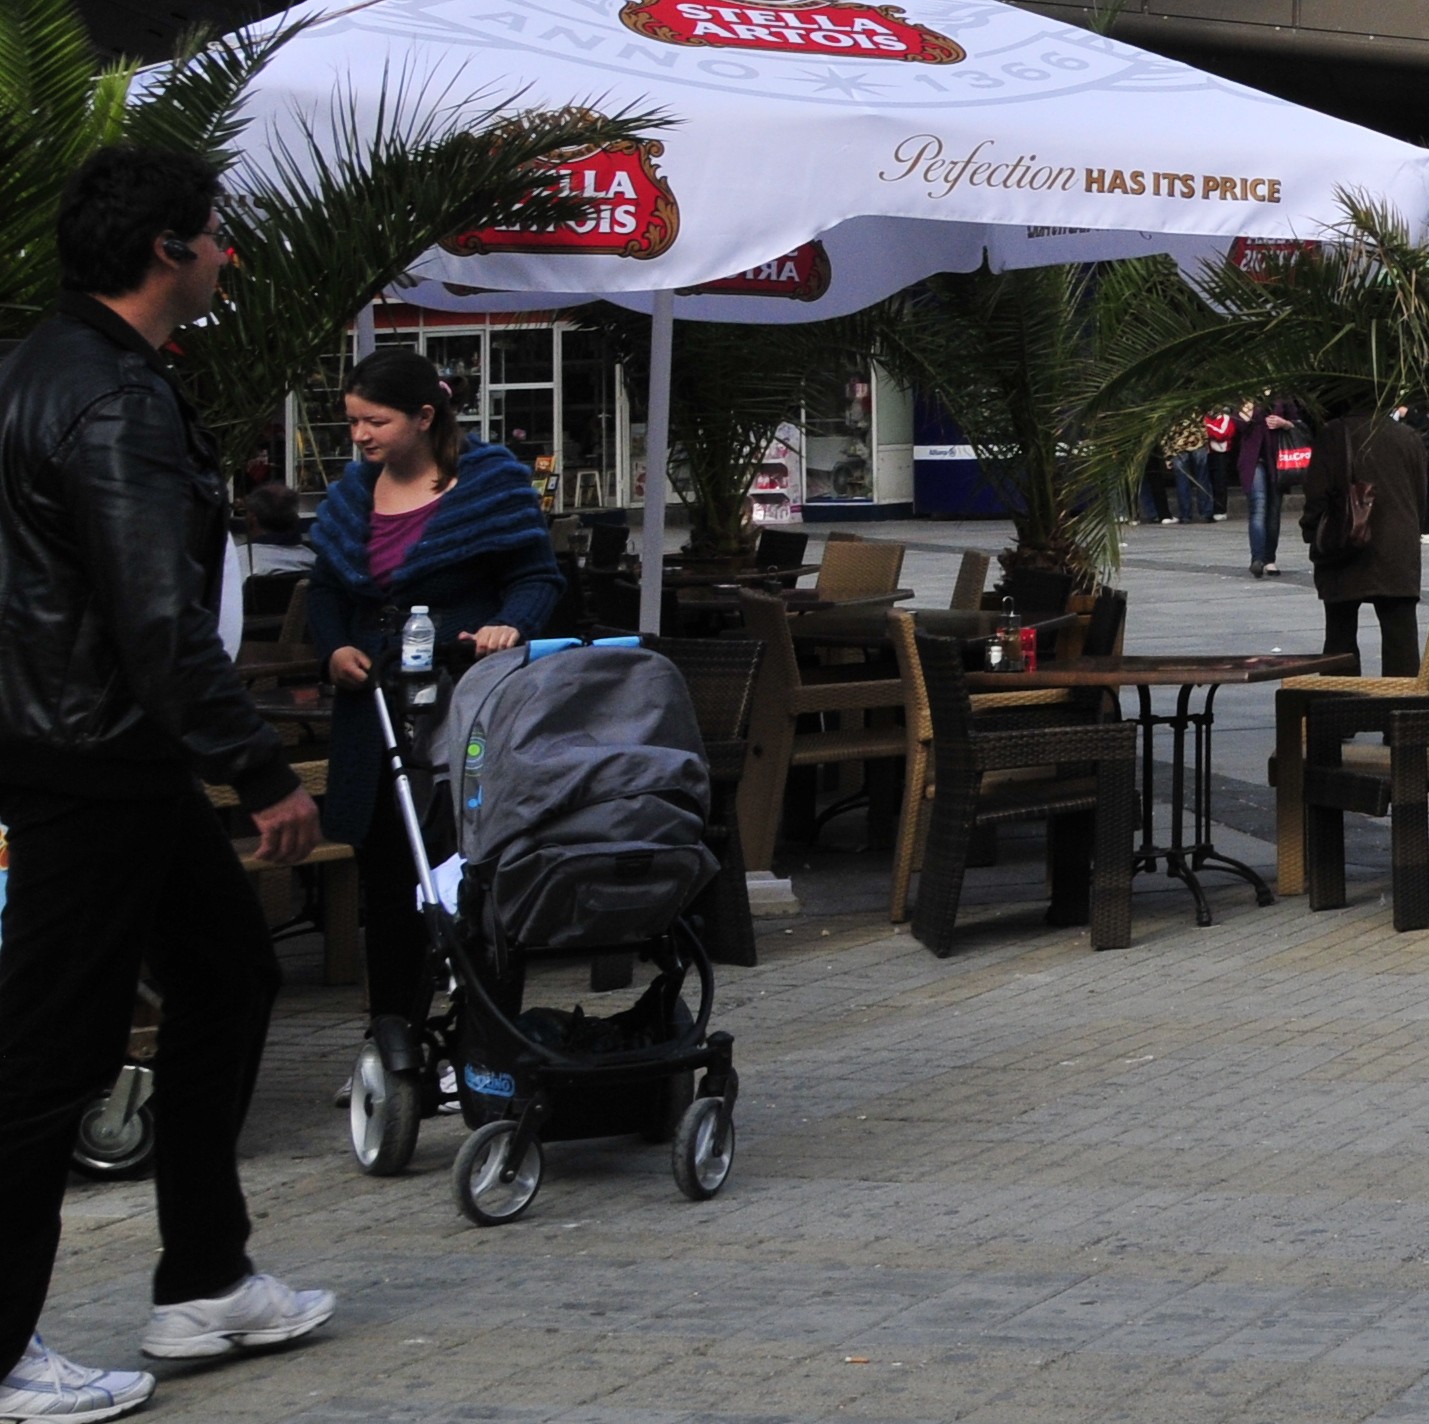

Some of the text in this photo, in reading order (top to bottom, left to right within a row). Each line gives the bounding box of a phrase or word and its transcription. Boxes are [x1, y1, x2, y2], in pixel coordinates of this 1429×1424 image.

[675, 1, 893, 34] STELLA
[692, 22, 909, 53] ARTOIS
[470, 13, 761, 79] ANNO
[913, 48, 1093, 94] 1366
[879, 133, 1282, 204] Perfection HAS ITS PRICE
